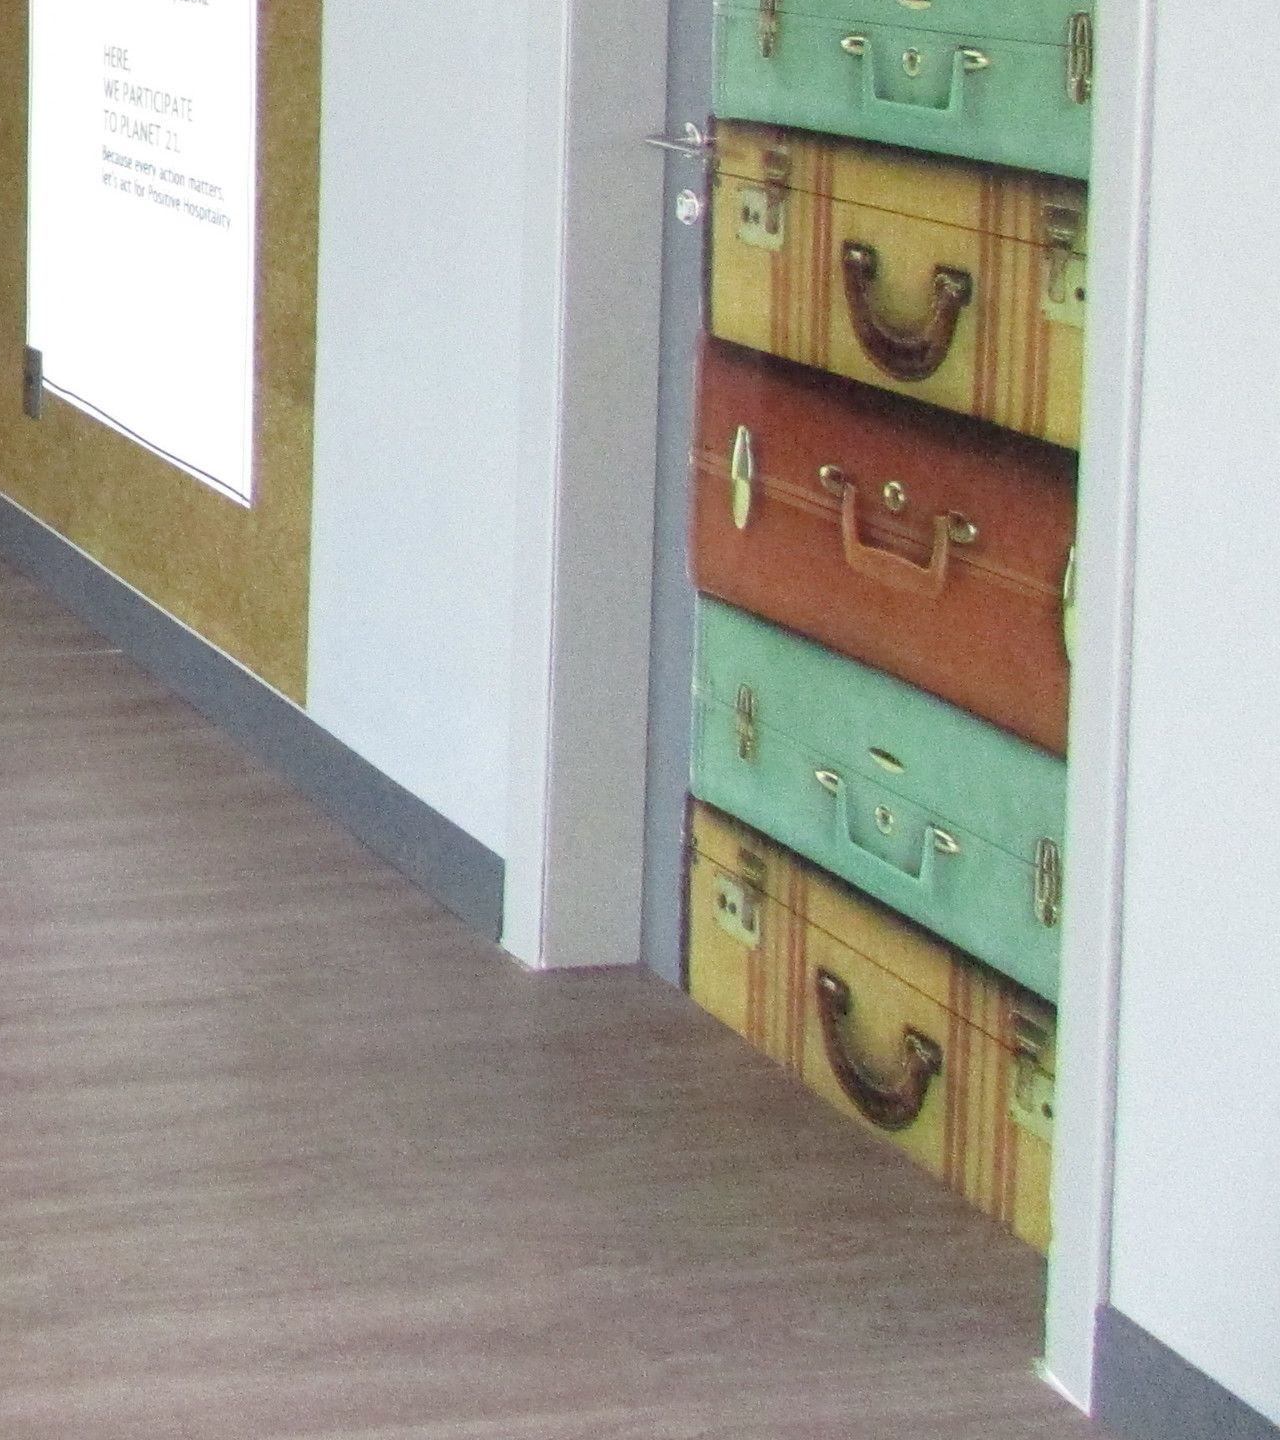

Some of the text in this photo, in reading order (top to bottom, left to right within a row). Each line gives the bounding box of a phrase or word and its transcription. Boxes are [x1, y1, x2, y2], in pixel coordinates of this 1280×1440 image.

[103, 77, 193, 122] WE PARTICIPATE
[104, 109, 118, 133] TO
[121, 114, 161, 147] PLANET
[102, 145, 133, 169] Because
[135, 159, 156, 177] every
[159, 166, 185, 185] action
[148, 185, 181, 211] Positive
